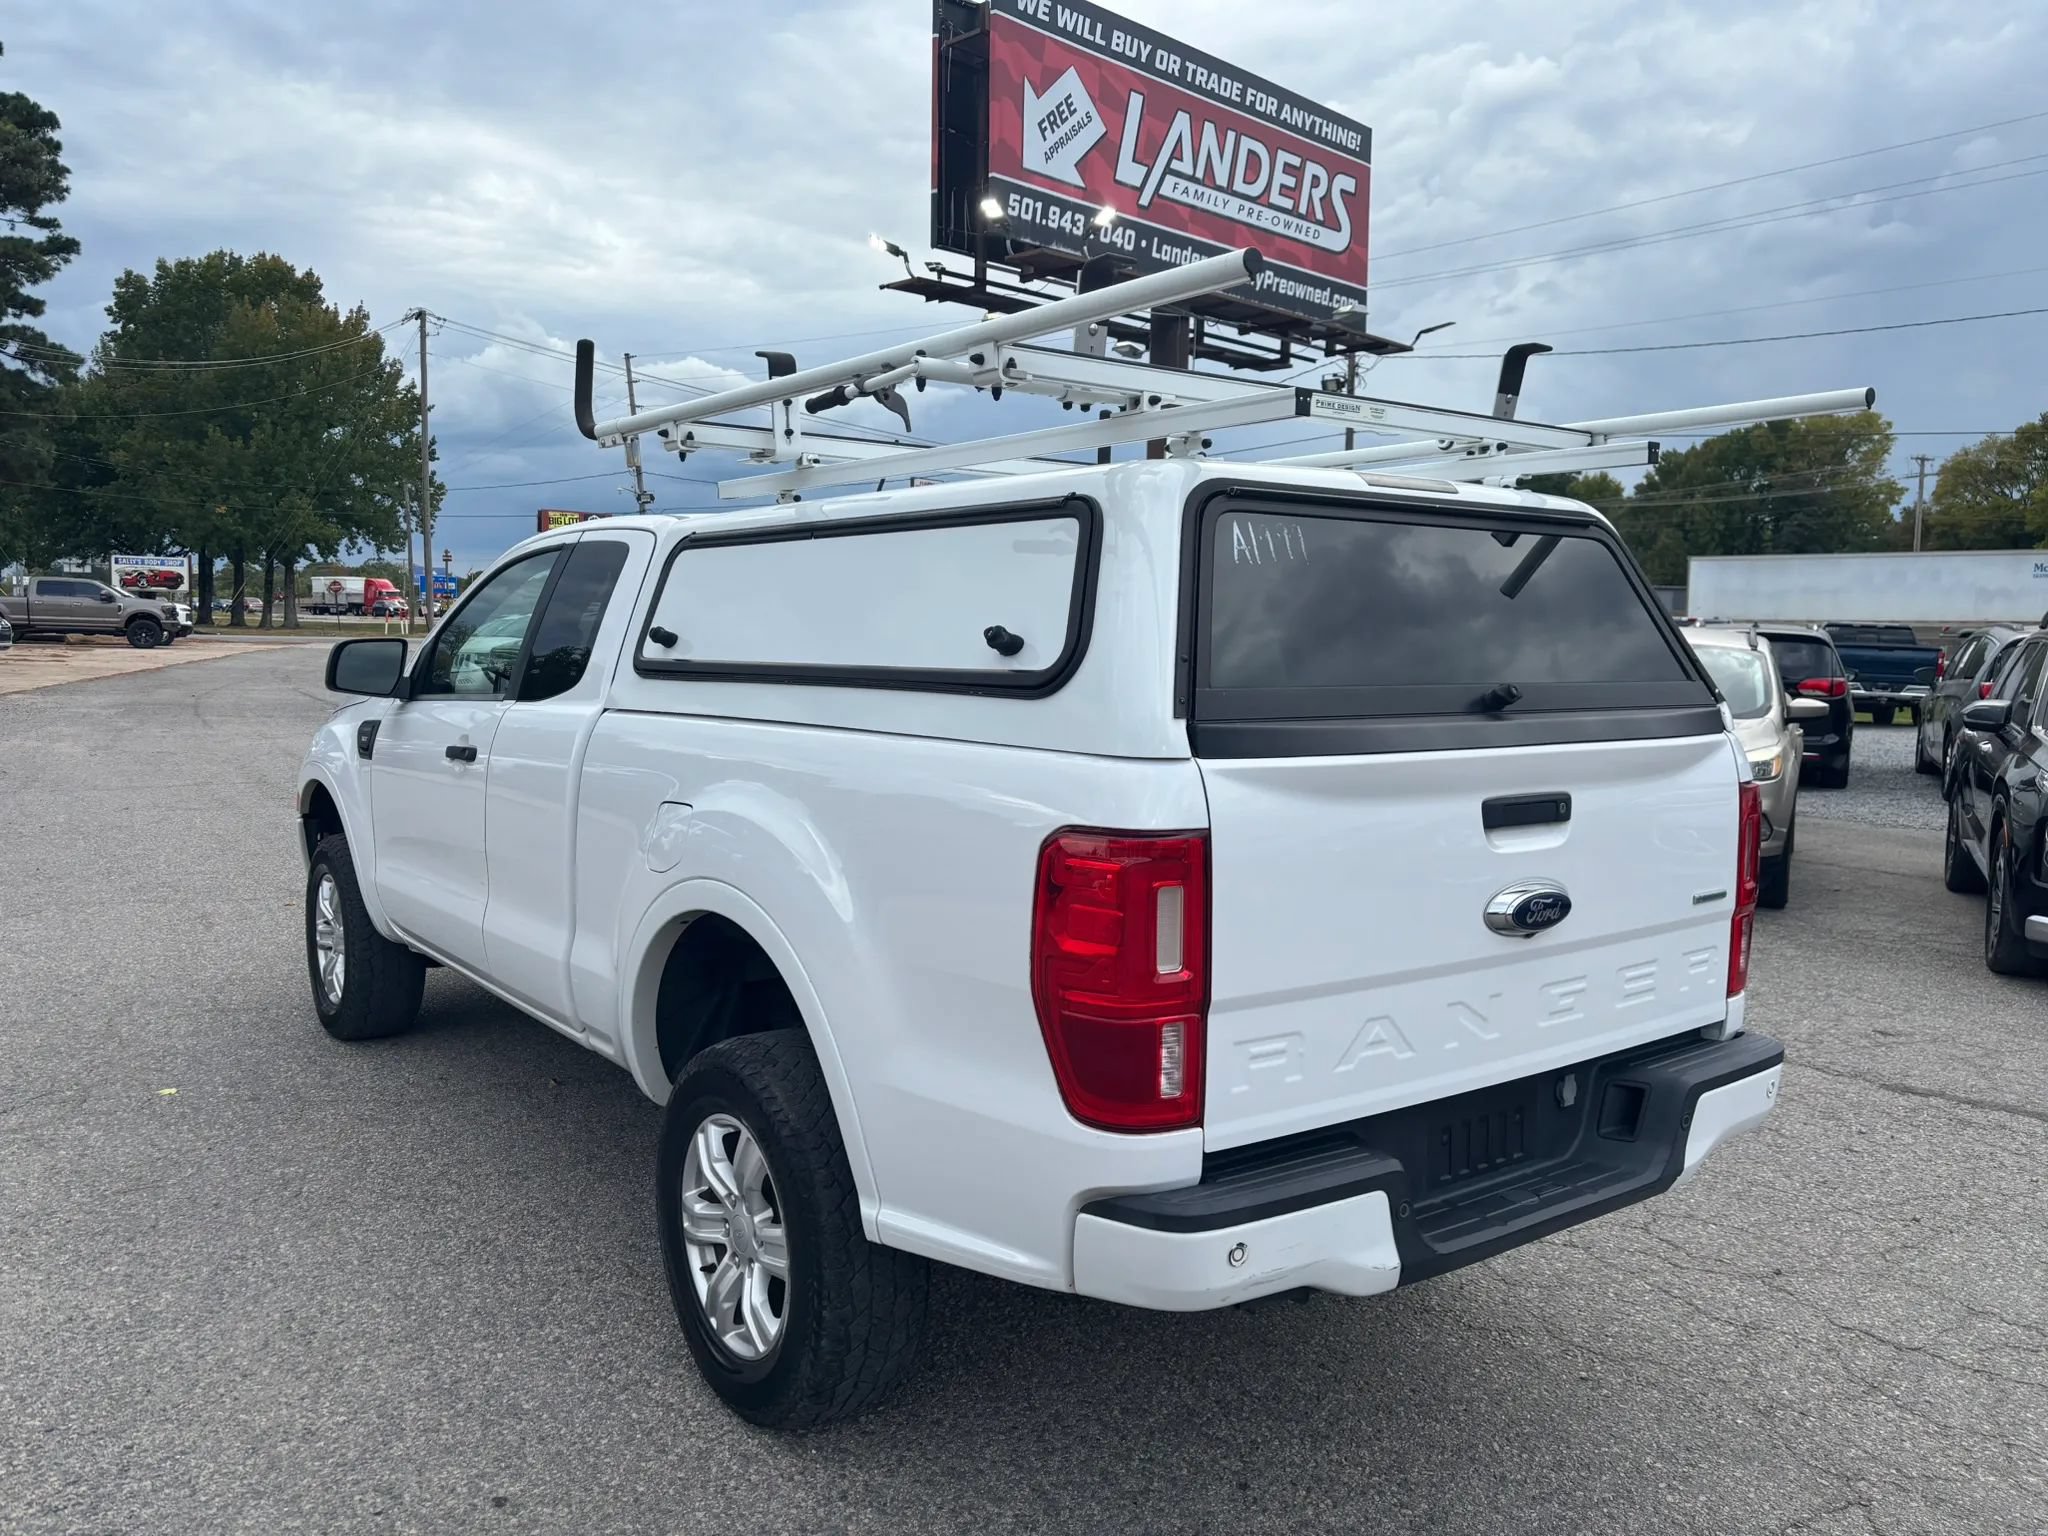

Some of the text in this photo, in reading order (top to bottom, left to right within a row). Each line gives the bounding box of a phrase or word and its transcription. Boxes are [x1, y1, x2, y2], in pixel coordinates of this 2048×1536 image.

[1016, 0, 1362, 151] WE WILL BUY OR TRADE FOR ANYTHING!
[1037, 93, 1078, 142] FREE
[1043, 111, 1093, 164] APPRAISALS
[1114, 89, 1357, 252] LANDERS
[1172, 182, 1321, 241] FAMILY PRE-OWNED
[1526, 897, 1562, 924] Ford
